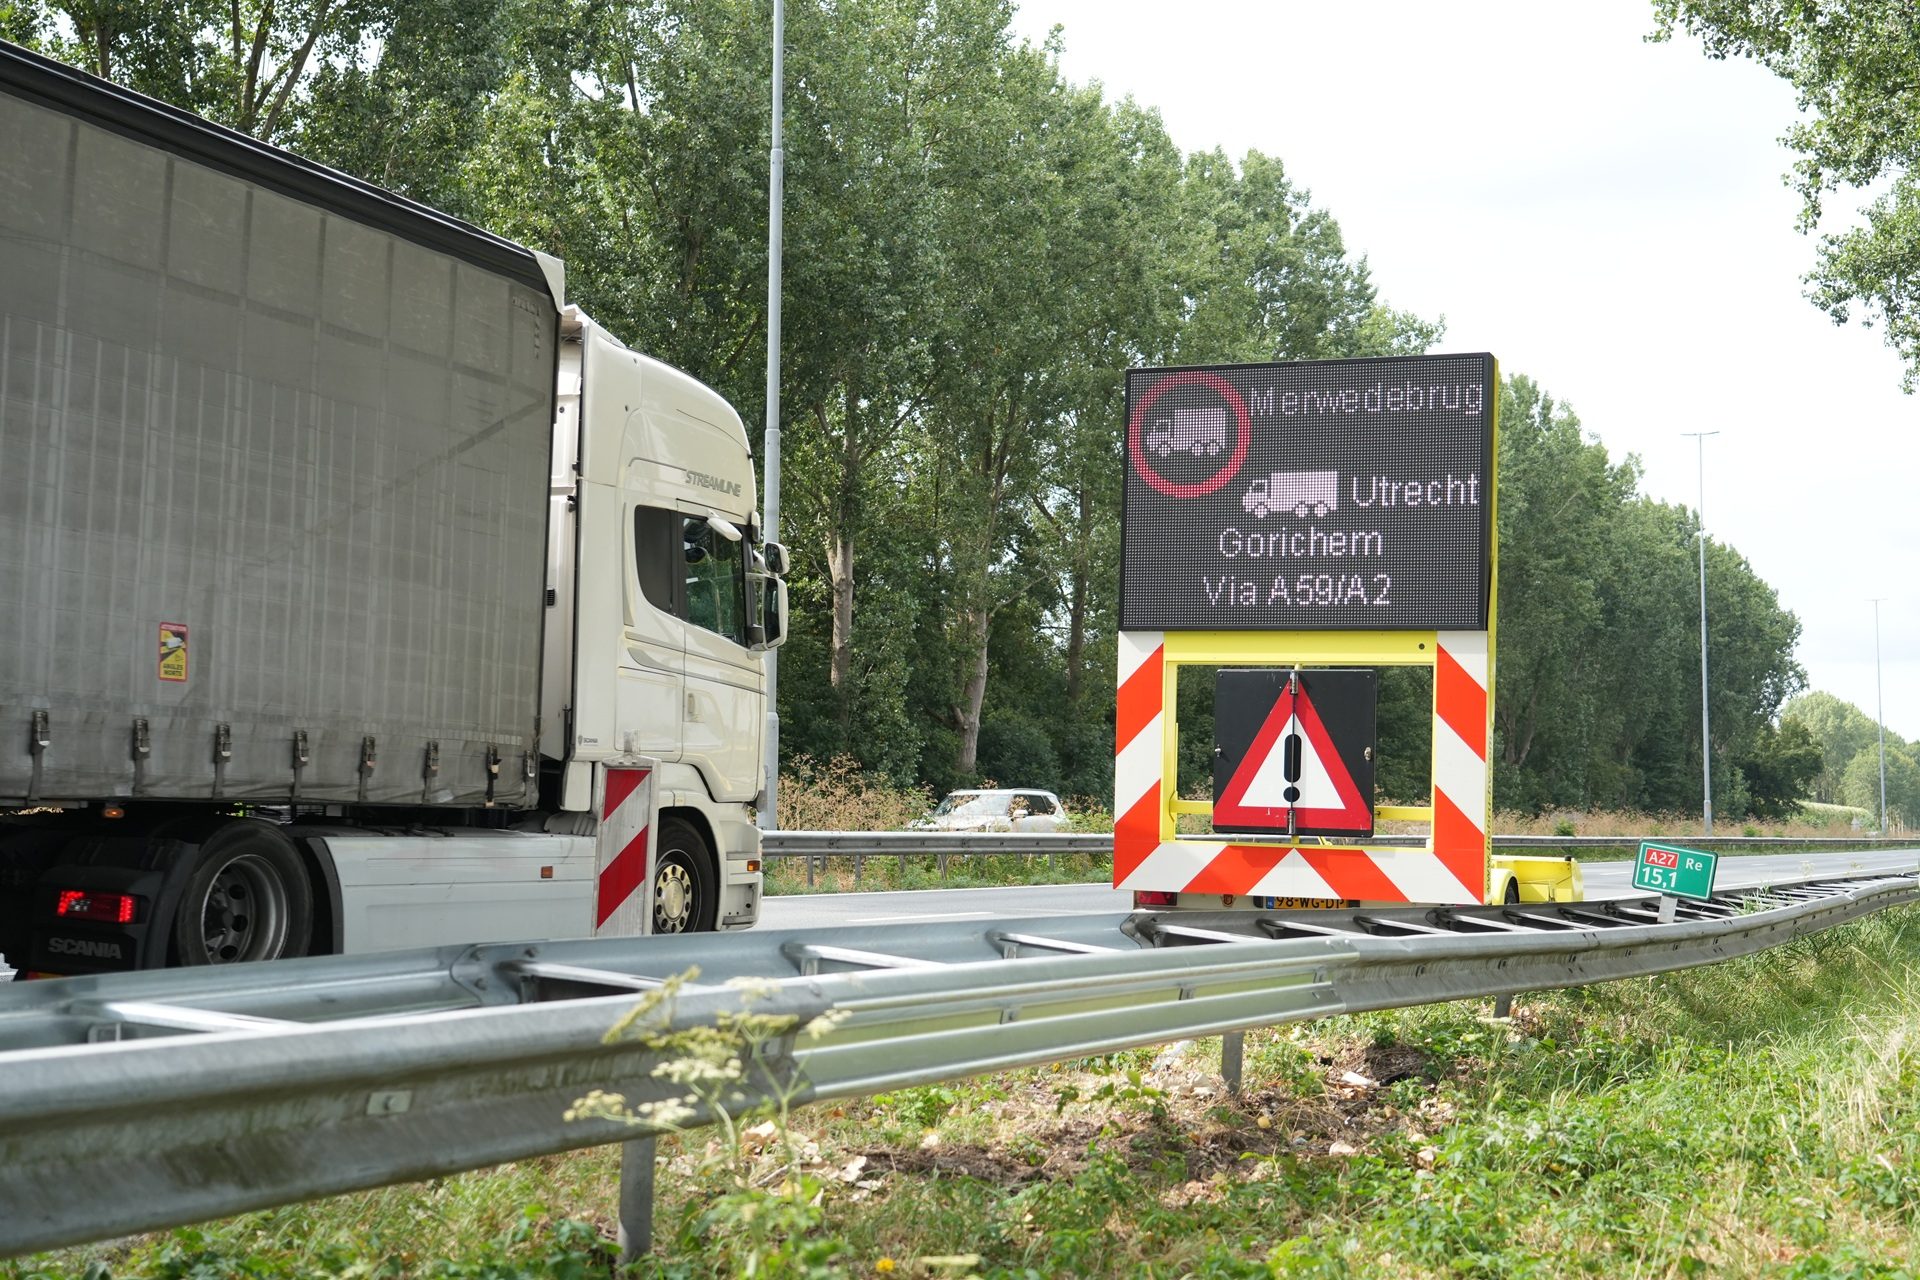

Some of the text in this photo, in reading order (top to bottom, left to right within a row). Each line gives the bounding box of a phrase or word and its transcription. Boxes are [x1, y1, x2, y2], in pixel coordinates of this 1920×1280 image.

[1250, 382, 1483, 415] Merwedebrug
[685, 470, 741, 497] STREAMLINE
[1352, 474, 1479, 506] Utrecht
[1219, 527, 1382, 557] Gorichem
[1203, 575, 1256, 605] Via
[1648, 851, 1675, 866] A27
[1685, 857, 1703, 871] Re
[1642, 866, 1678, 888] 15,1
[47, 937, 122, 960] SCANIA
